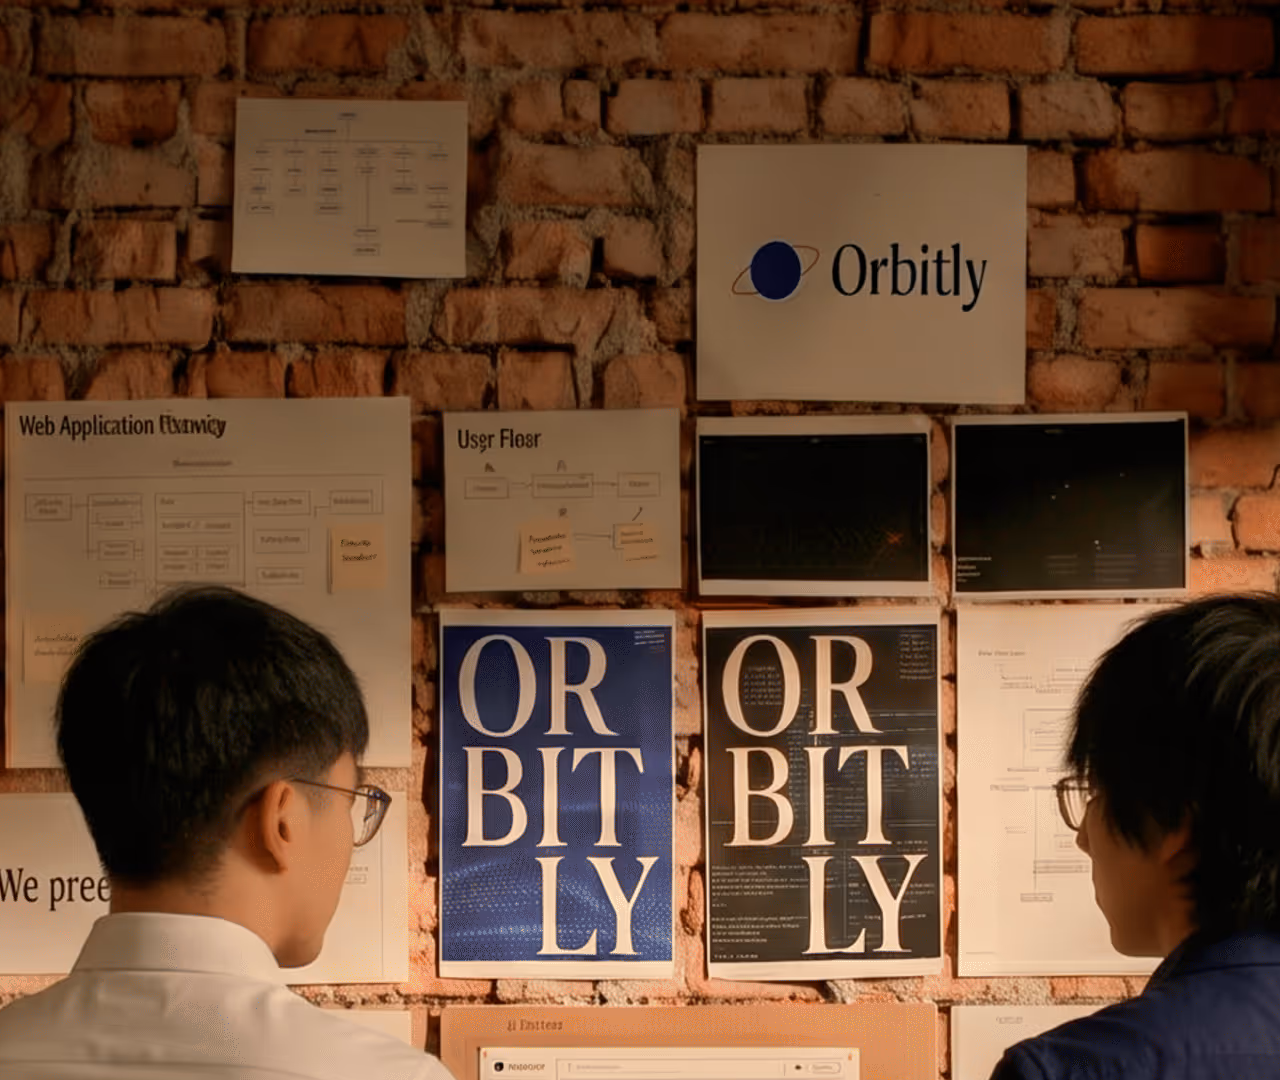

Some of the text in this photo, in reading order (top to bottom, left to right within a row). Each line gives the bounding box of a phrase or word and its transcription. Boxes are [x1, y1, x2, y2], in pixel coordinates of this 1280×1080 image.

[831, 242, 988, 313] Orbitly
[19, 414, 55, 436] Web
[59, 413, 154, 441] Application
[459, 634, 620, 738] OR
[722, 634, 884, 738] OR
[461, 745, 645, 848] BIT
[722, 745, 910, 848] BIT
[534, 855, 661, 956] LY
[801, 854, 929, 955] LY
